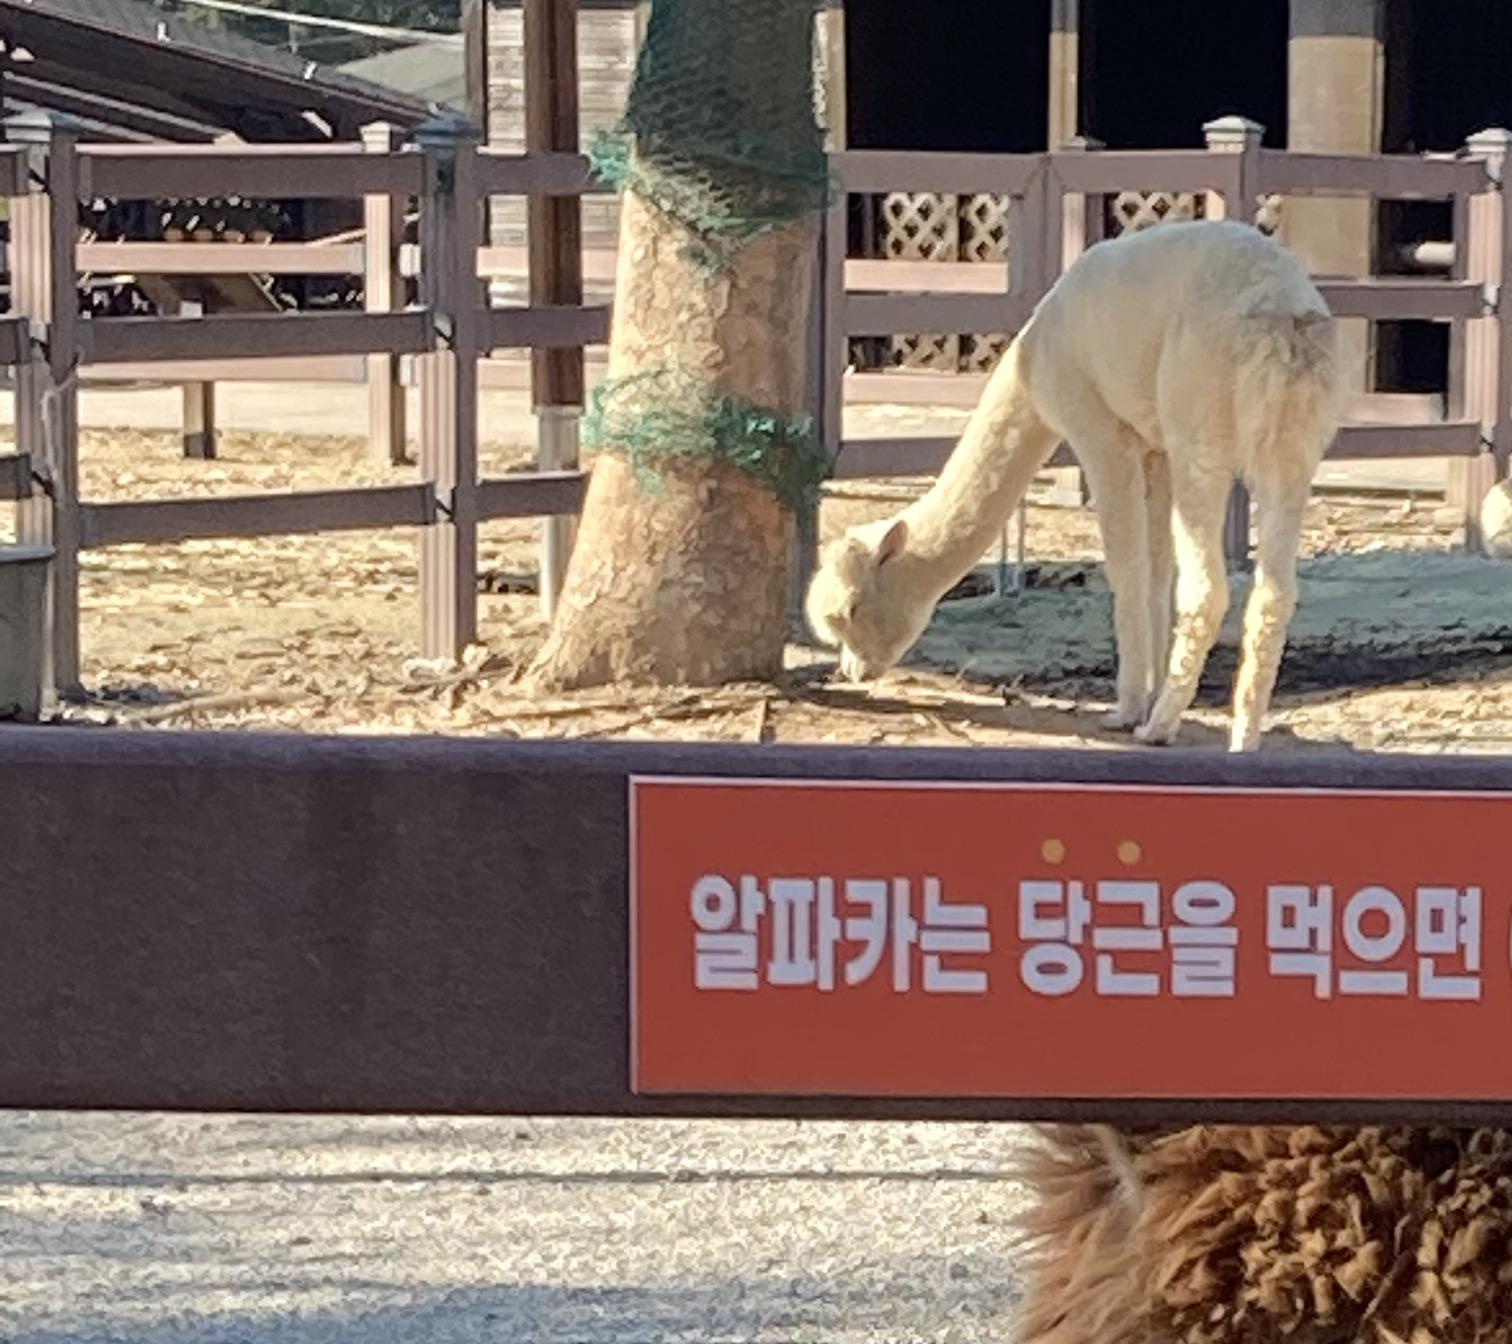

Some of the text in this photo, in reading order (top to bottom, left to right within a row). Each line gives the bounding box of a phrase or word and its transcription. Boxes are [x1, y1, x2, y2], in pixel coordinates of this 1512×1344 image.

[690, 874, 991, 992] 알파카는
[1018, 880, 1239, 996] 당근을
[1266, 884, 1482, 1000] 먹으면
